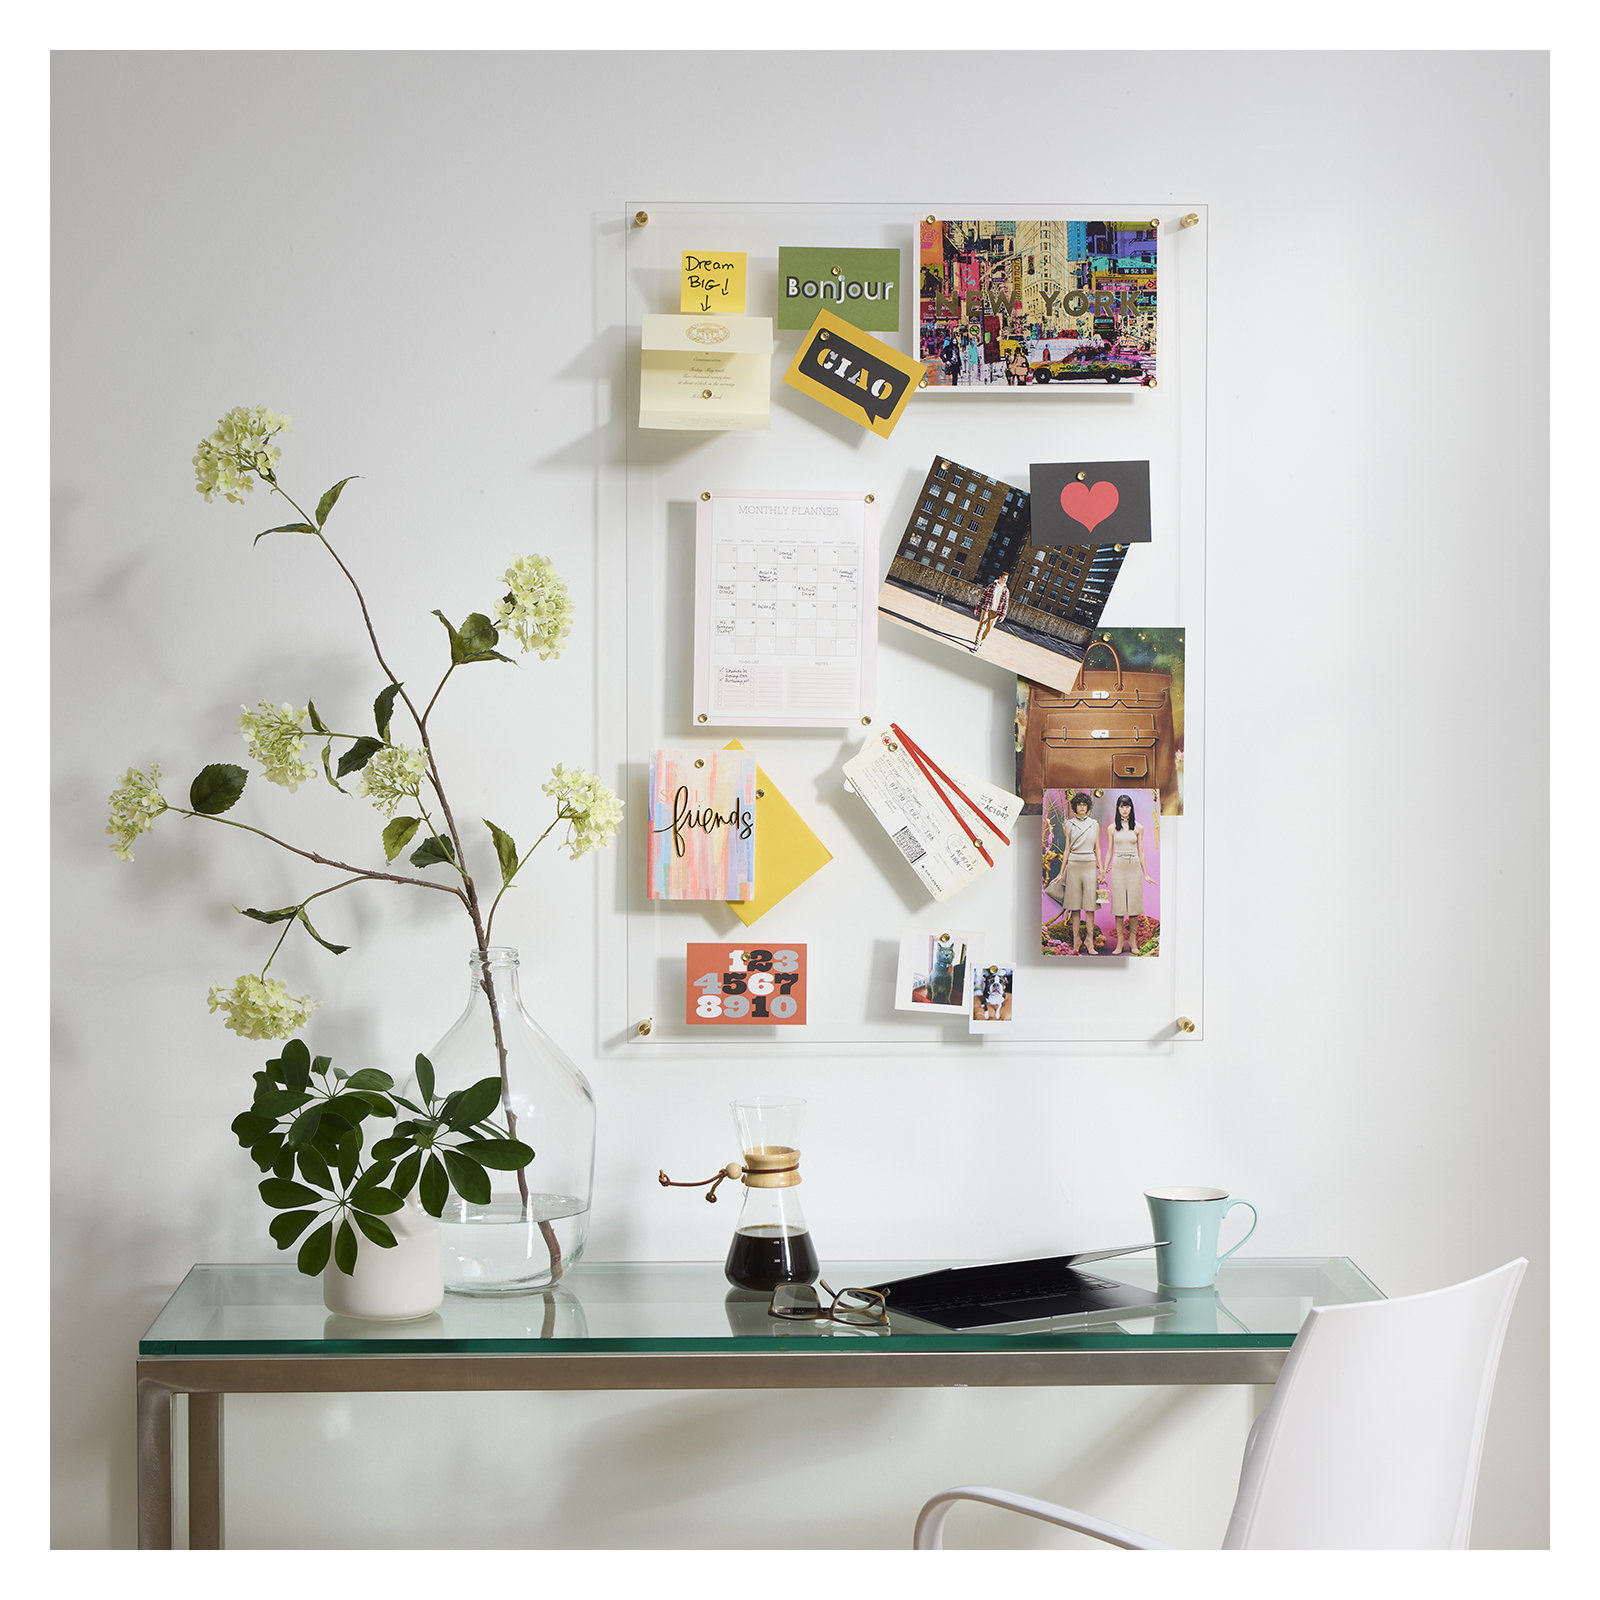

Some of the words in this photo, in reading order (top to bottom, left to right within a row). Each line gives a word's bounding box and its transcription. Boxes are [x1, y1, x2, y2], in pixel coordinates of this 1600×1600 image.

[685, 256, 734, 271] Dream
[786, 275, 894, 304] Bonjour
[936, 290, 1019, 317] NEW
[1039, 290, 1142, 317] YORK
[817, 348, 893, 401] CIAO
[738, 505, 788, 516] MONTHLY
[792, 506, 839, 516] PLANNER
[653, 786, 753, 858] friends
[983, 804, 1009, 821] AC1042
[694, 972, 799, 995] 4567
